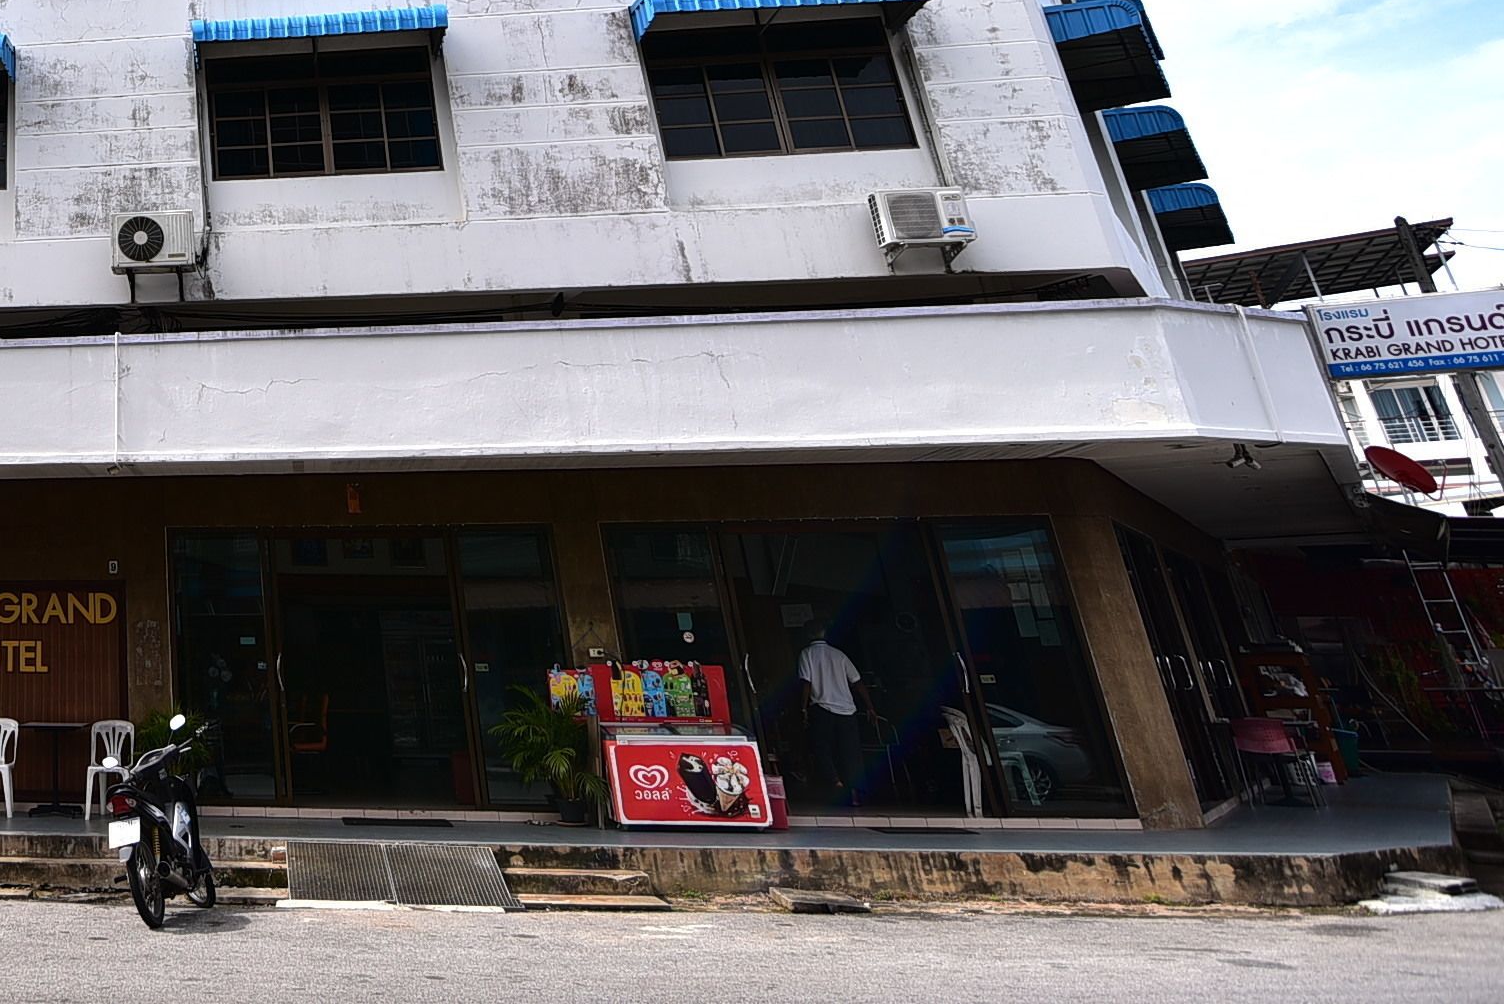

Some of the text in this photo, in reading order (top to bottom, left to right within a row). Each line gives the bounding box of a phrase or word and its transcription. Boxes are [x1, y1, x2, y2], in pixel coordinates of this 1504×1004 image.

[1316, 308, 1369, 321] โรงแรม
[1324, 309, 1395, 344] กระบี่
[1330, 346, 1382, 361] KRABI
[1387, 340, 1454, 356] GRAND
[1453, 357, 1465, 365] 66
[1466, 355, 1480, 363] 75
[634, 787, 670, 800] วอลล์
